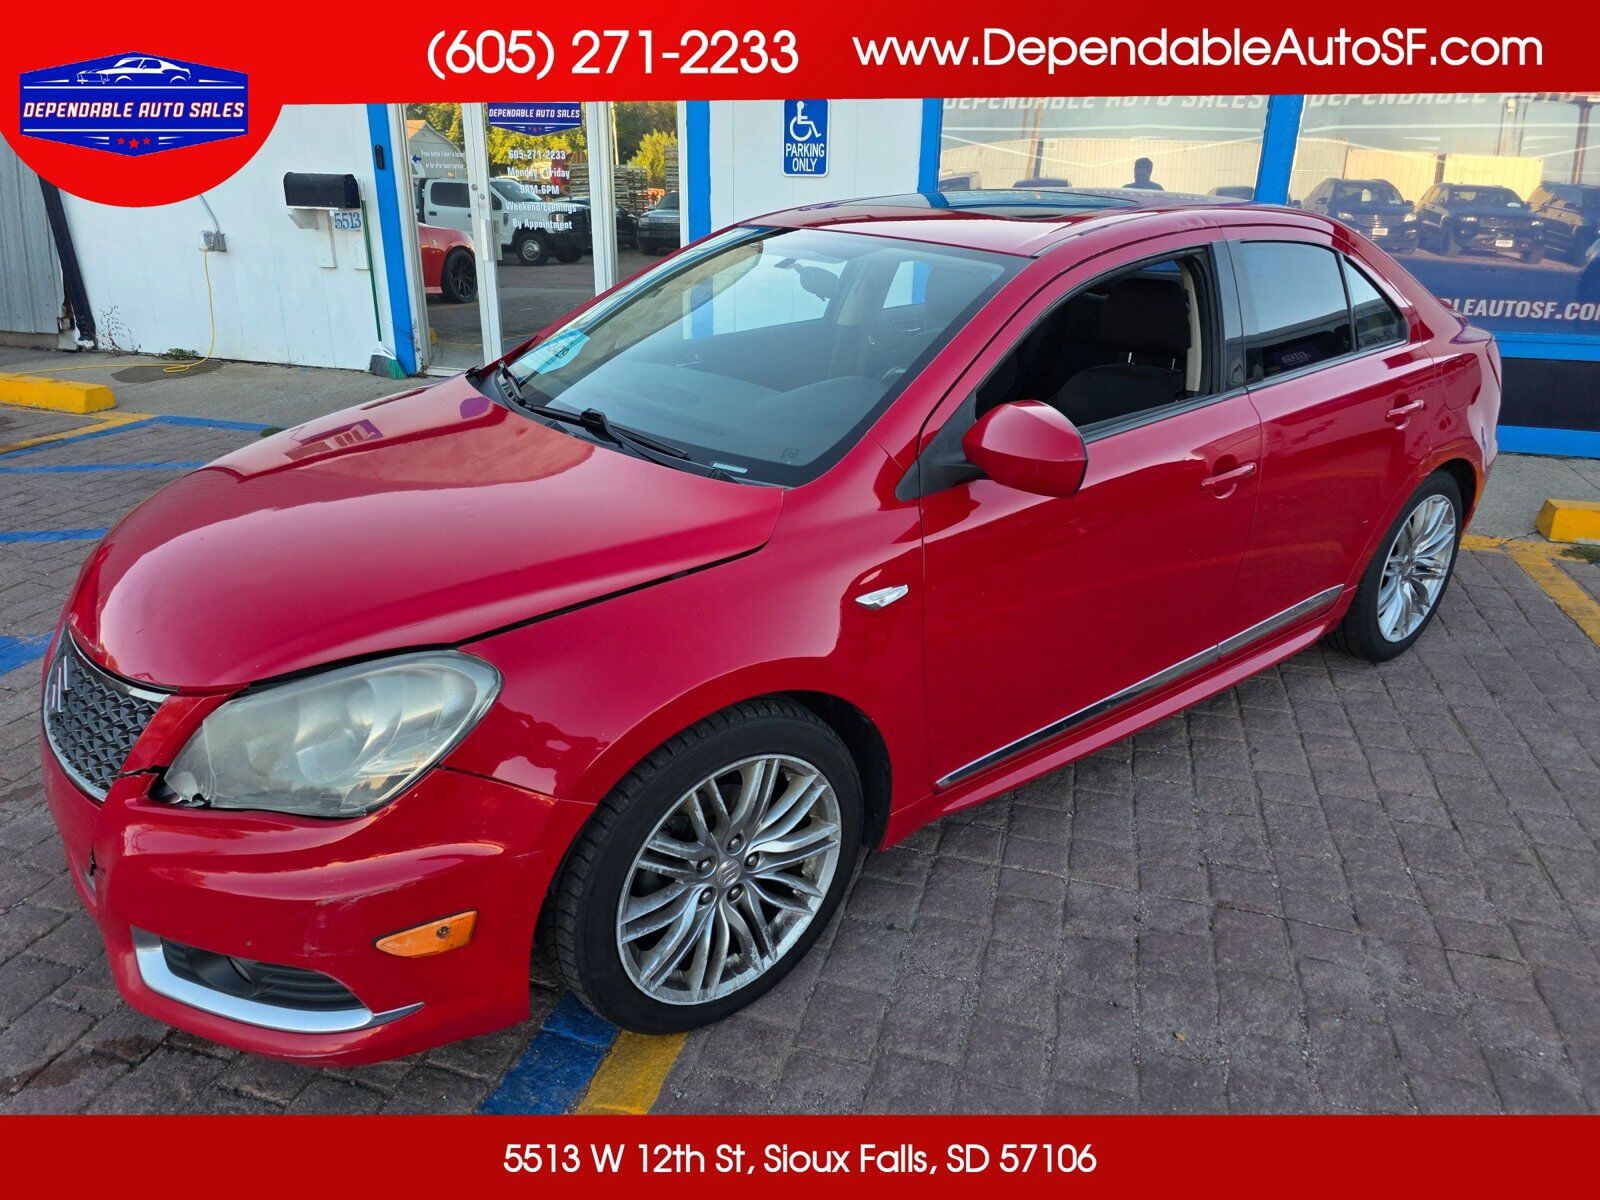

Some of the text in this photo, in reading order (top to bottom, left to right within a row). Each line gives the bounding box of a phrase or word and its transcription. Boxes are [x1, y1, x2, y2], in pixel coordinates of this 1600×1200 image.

[488, 108, 580, 119] DEPENDABLE AUTO SALES
[508, 149, 566, 160] 605-271-2233
[785, 142, 825, 158] PARKING
[792, 157, 818, 172] ONLY
[507, 167, 538, 179] Monday
[520, 184, 560, 195] 9AM-6PM
[334, 211, 362, 230] 5513
[512, 218, 573, 230] By Appointment
[1440, 298, 1600, 321] LEAUTOSF.CO
